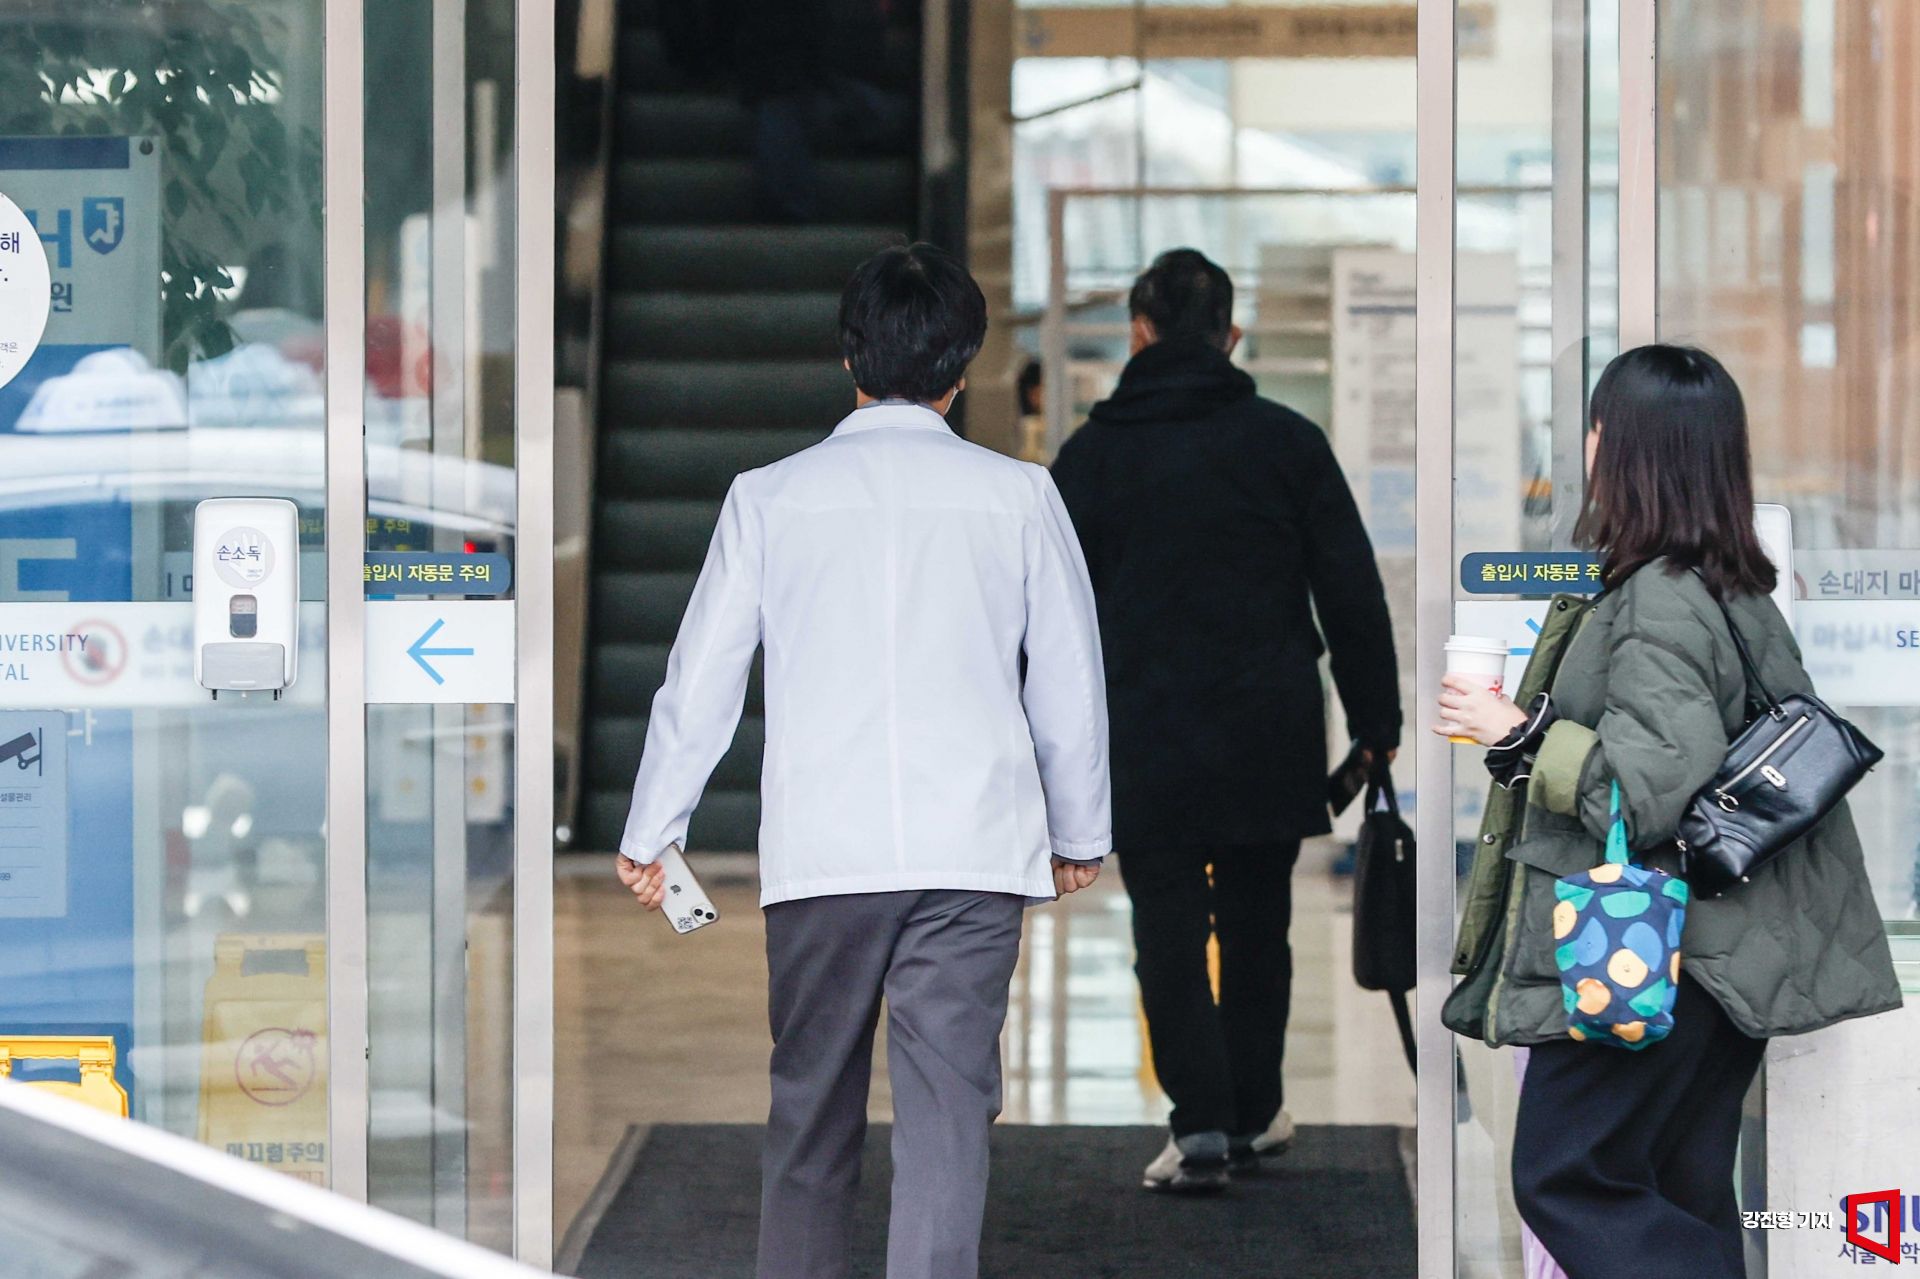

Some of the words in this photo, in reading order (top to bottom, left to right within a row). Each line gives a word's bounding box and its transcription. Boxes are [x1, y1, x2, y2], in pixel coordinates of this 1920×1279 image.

[216, 545, 261, 561] 손소독
[408, 564, 454, 582] 자동문
[459, 564, 490, 582] 주의
[1481, 564, 1527, 581] 출입시
[1533, 564, 1580, 581] 자동문
[1818, 570, 1888, 595] 손대지
[1838, 1242, 1920, 1265] 서울학
